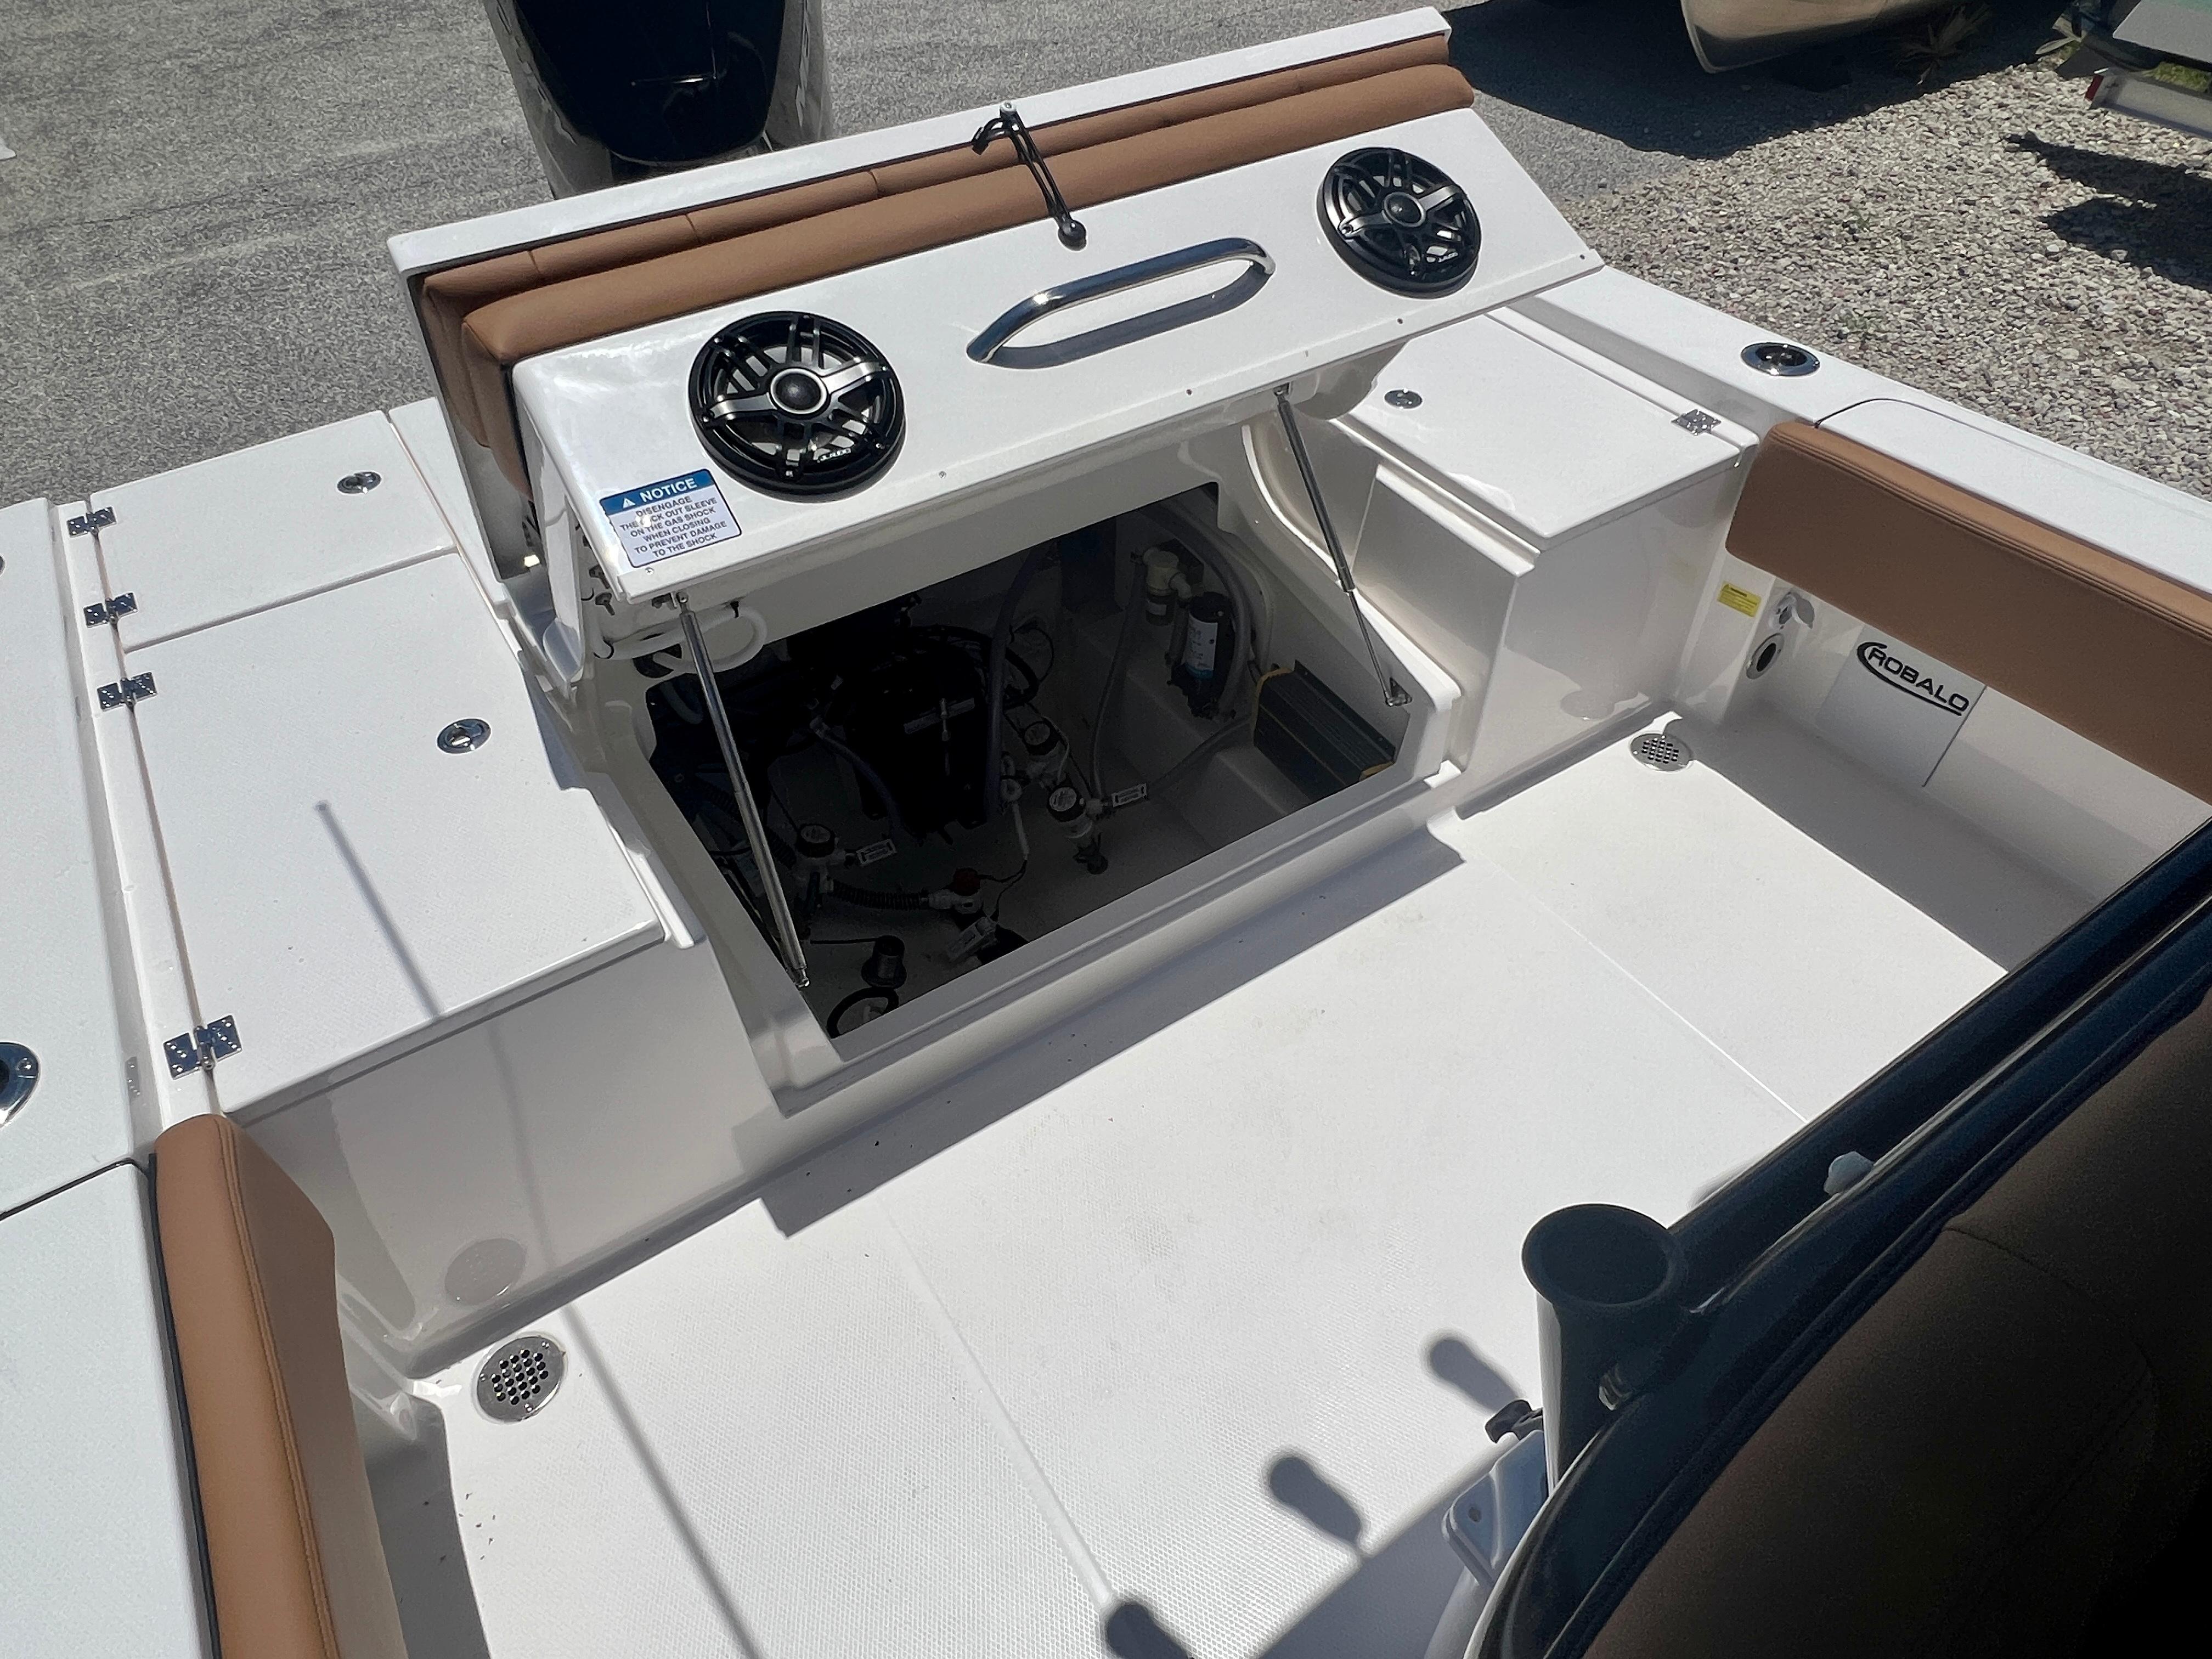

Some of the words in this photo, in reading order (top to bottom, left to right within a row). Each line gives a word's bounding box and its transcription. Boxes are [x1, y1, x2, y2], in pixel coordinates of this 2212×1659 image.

[640, 478, 698, 503] NOTICE
[619, 521, 639, 531] THE
[665, 507, 683, 518] OUT
[684, 497, 718, 512] SLEEVE
[636, 496, 692, 517] DISENGAGE
[630, 528, 645, 537] ON
[645, 522, 663, 532] THE
[665, 516, 684, 527] GAS
[684, 506, 716, 521] SHOCK
[643, 529, 670, 542] WHEN
[672, 517, 710, 533] CLOSING
[634, 545, 647, 554] TO
[648, 533, 688, 550] PREVENT
[690, 521, 727, 538] DAMAGE
[652, 549, 666, 557] TO
[667, 543, 685, 553] THE
[686, 532, 717, 548] SHOCK
[1867, 647, 1970, 712] ROBALO
